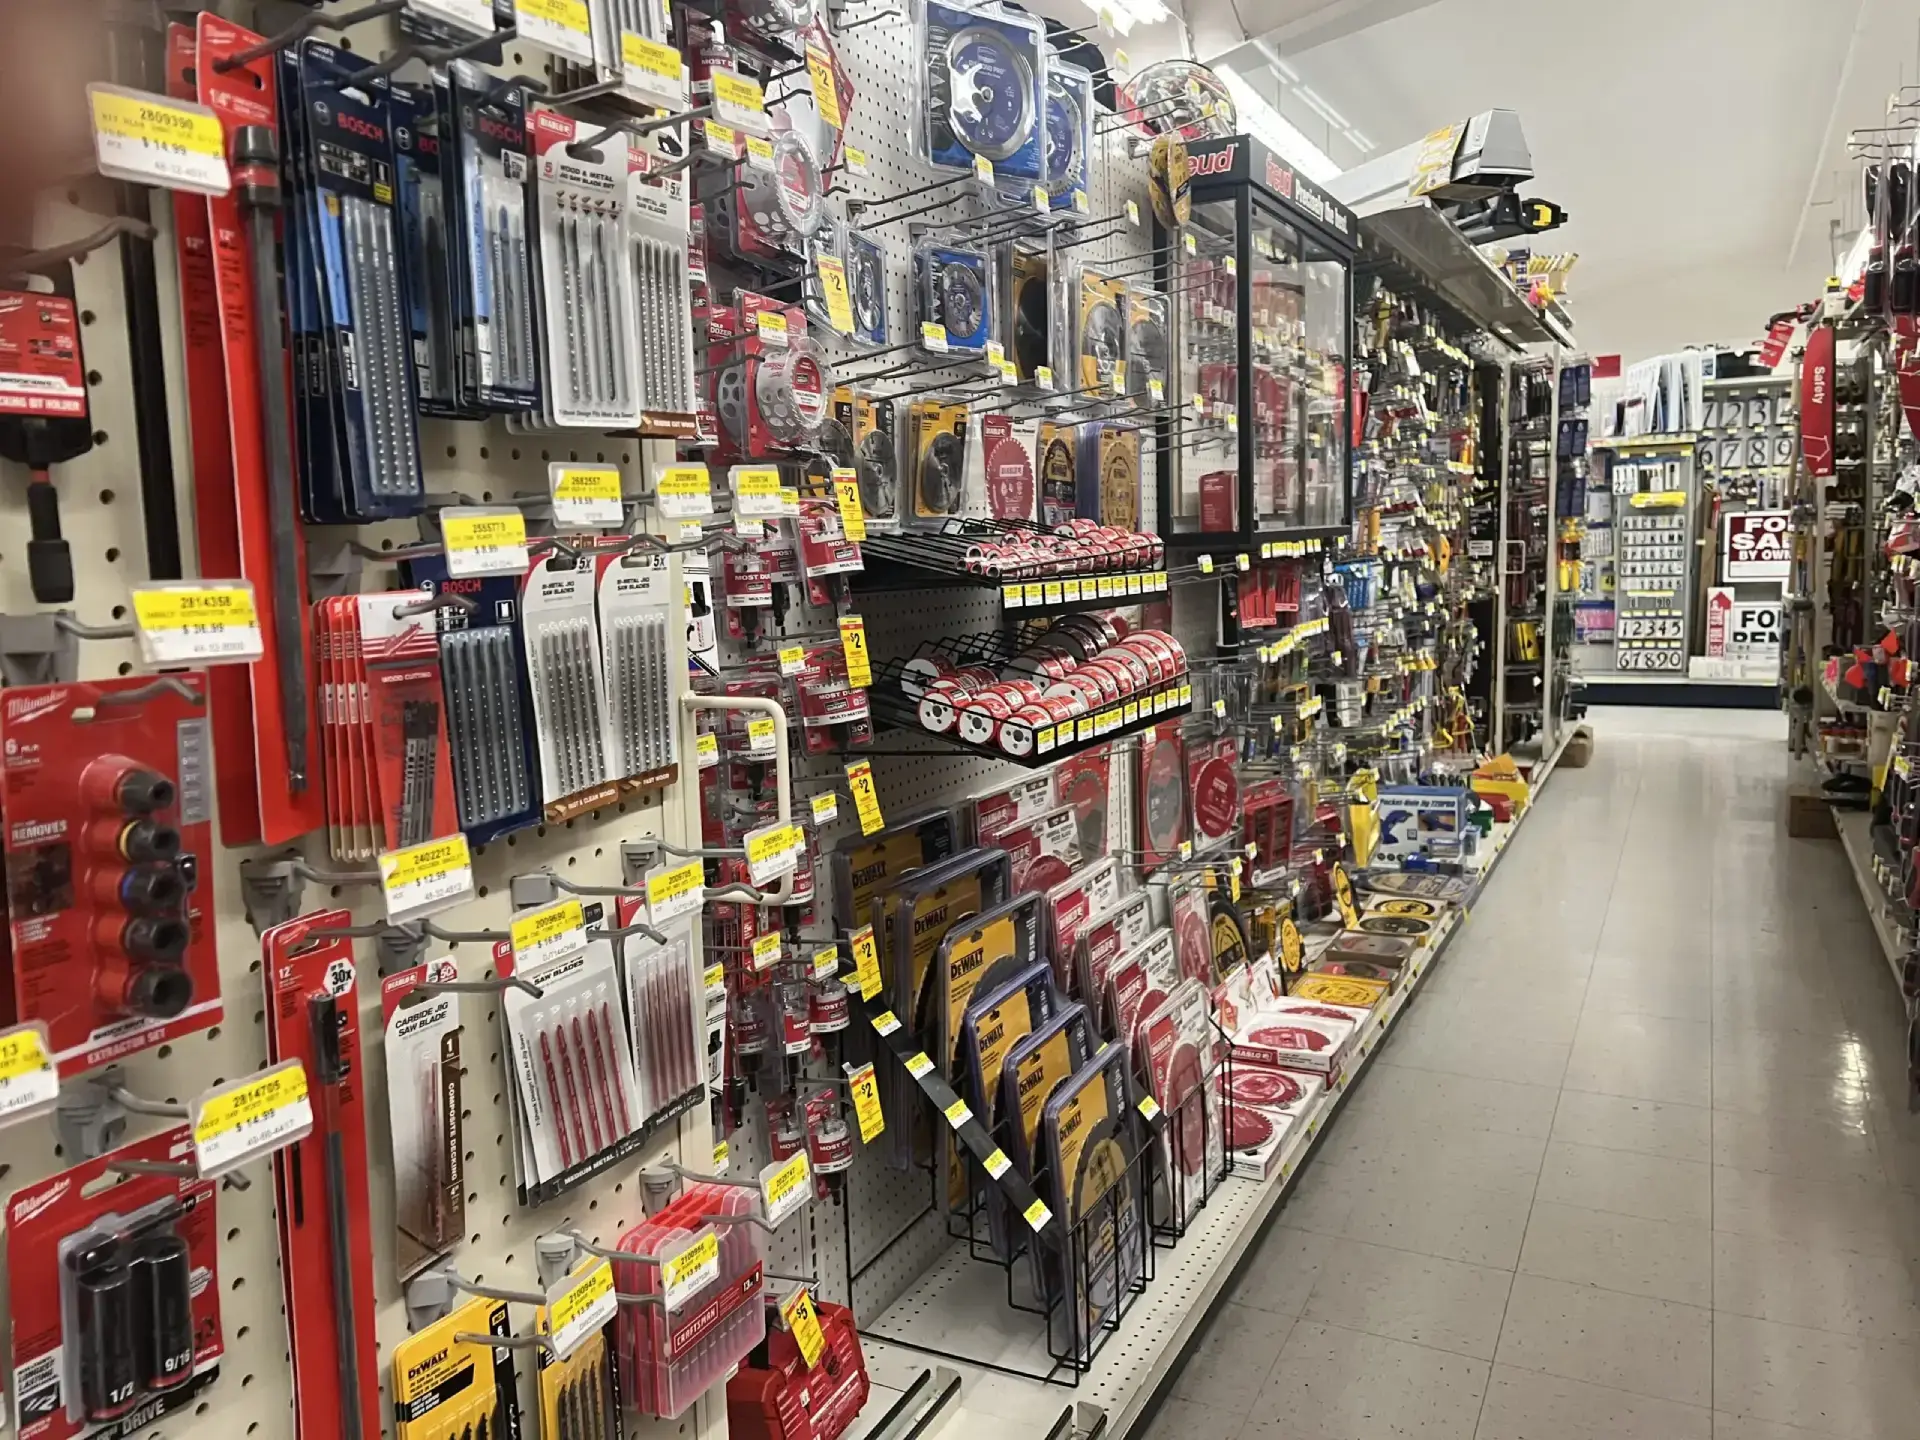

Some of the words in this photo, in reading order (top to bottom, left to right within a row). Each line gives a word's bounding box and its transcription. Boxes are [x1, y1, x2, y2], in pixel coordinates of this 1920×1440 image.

[337, 112, 385, 143] BOSCH
[479, 116, 523, 145] BOSCH
[1188, 143, 1235, 176] eud
[1812, 366, 1826, 406] Safety
[1724, 442, 1740, 468] 7
[1750, 440, 1765, 467] 8
[1777, 439, 1792, 465] 9
[843, 485, 856, 502] $2
[578, 557, 592, 570] 5X
[653, 555, 665, 567] 5X
[1738, 550, 1758, 561] BY
[441, 579, 482, 594] BOSCH
[849, 632, 862, 648] $2
[1619, 652, 1630, 669] 6
[1644, 652, 1655, 669] 8
[1656, 652, 1668, 667] 9
[1670, 651, 1681, 667] 0
[7, 688, 68, 719] Milwaukee
[5, 738, 17, 755] 6
[858, 778, 871, 794] $2
[914, 906, 949, 936] DEWALT
[861, 942, 873, 959] $2
[950, 948, 984, 980] DEWALT
[534, 973, 552, 986] SAW
[552, 959, 585, 978] BLADES
[395, 1006, 434, 1029] CARBIDE
[434, 1001, 449, 1013] JIG
[398, 1025, 419, 1038] SAW
[419, 1010, 447, 1029] BLADE
[87, 1031, 146, 1065] EXTRACTOR
[147, 1028, 166, 1043] SET
[446, 1038, 453, 1052] 1
[979, 1022, 1004, 1050] DEWALT
[861, 1082, 873, 1099] $2
[1020, 1066, 1044, 1096] DEWALT
[1059, 1111, 1082, 1141] DEWALT
[450, 1139, 458, 1181] DECKING
[564, 1165, 592, 1185] MEDIUM
[593, 1153, 616, 1173] METAL
[568, 1276, 597, 1304] 2100949
[796, 1302, 808, 1320] $5
[676, 1307, 717, 1347] CRAFTSMAN
[164, 1348, 191, 1372] 9/16
[408, 1348, 449, 1379] DEWALT
[110, 1381, 134, 1404] 1/2
[121, 1397, 166, 1436] DRIVE
